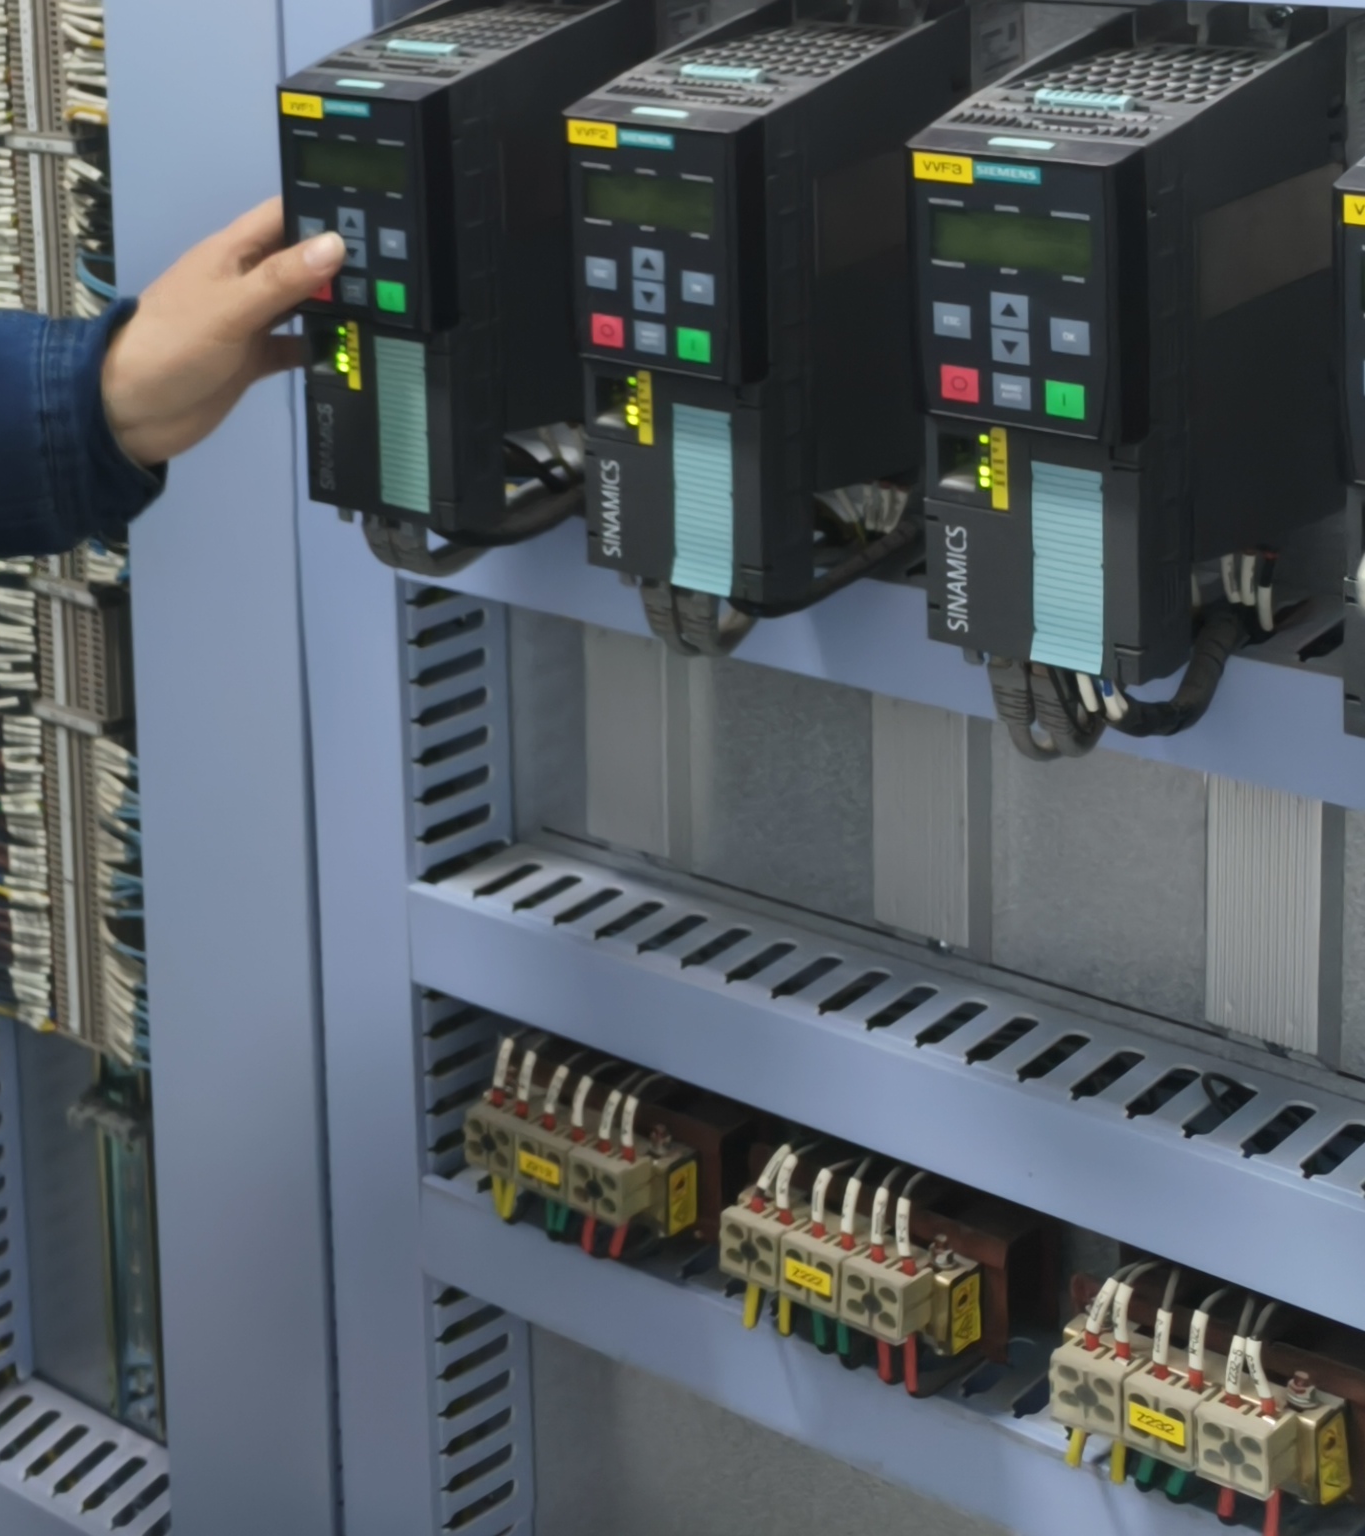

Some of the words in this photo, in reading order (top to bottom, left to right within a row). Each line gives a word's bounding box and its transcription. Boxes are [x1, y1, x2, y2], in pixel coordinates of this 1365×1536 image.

[975, 165, 1037, 181] SIEMENS
[601, 459, 621, 557] SINAMICS
[945, 524, 969, 633] SINAMICS
